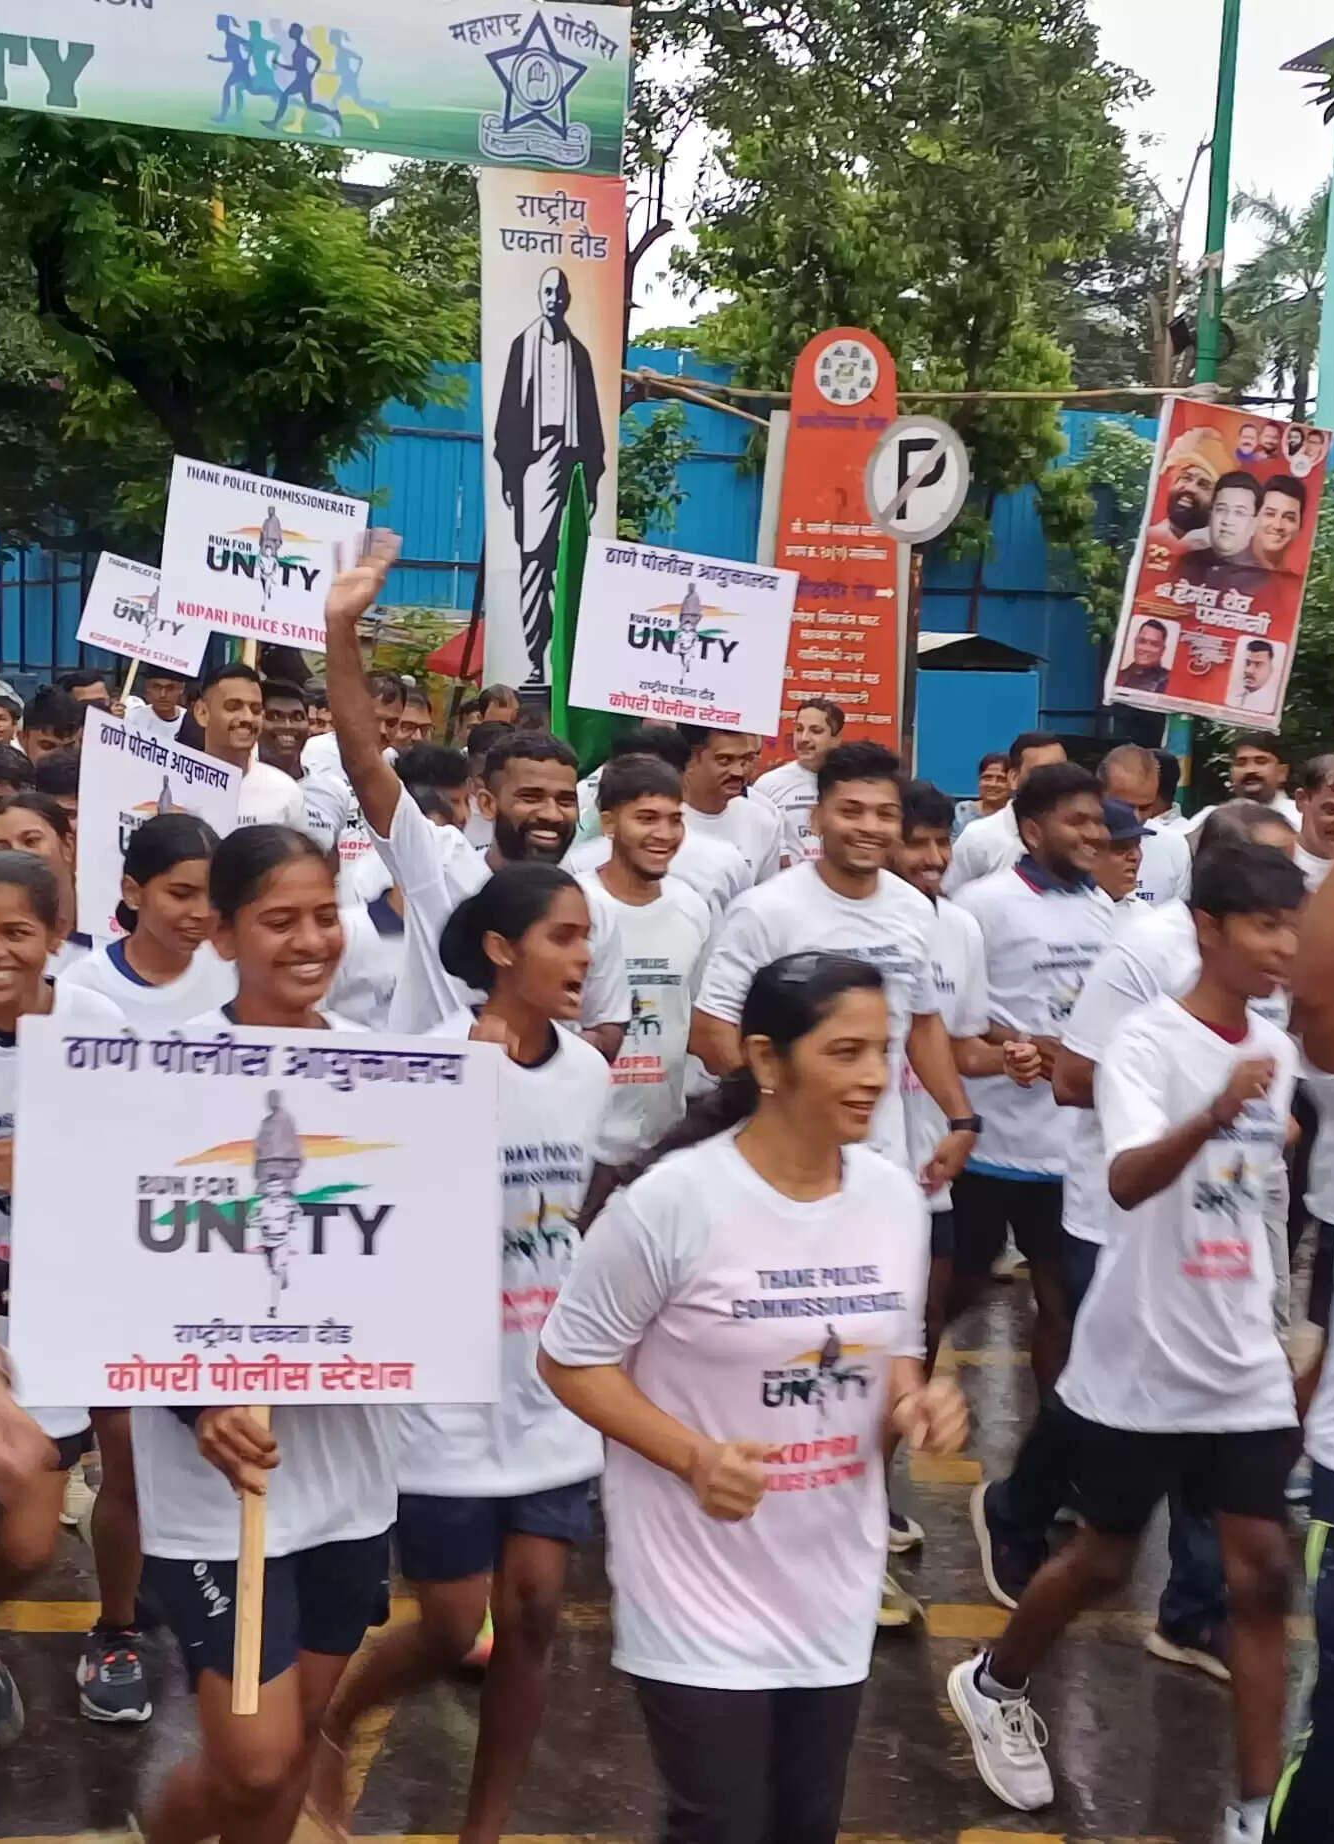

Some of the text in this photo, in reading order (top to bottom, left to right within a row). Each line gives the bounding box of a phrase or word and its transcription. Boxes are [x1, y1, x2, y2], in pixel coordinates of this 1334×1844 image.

[449, 13, 619, 61] महाराष्ट्र पोलीस
[516, 190, 587, 225] राष्ट्रीय
[499, 225, 608, 260] एकता दौड
[186, 465, 356, 517] THANE POLICE COMMISSIONERATE
[895, 437, 947, 520] P
[208, 534, 253, 553] RUN FOR
[605, 546, 638, 568] ठाणे
[641, 550, 694, 577] पोलीस
[177, 600, 328, 645] KOPARI POLICE STATIO
[630, 612, 673, 628] RUN FOR
[609, 691, 742, 726] कोपरी पोलीस स्टेशन
[100, 723, 126, 752] ठाणे
[128, 731, 169, 768] पोलीस
[63, 1028, 140, 1073] ठाणे
[149, 1030, 273, 1078] पोलीस
[137, 1175, 239, 1197] RUN FOR
[173, 1317, 354, 1349] राष्ट्रीय एकता दौड
[105, 1353, 415, 1394] कोपरी पोलीस स्टेशन
